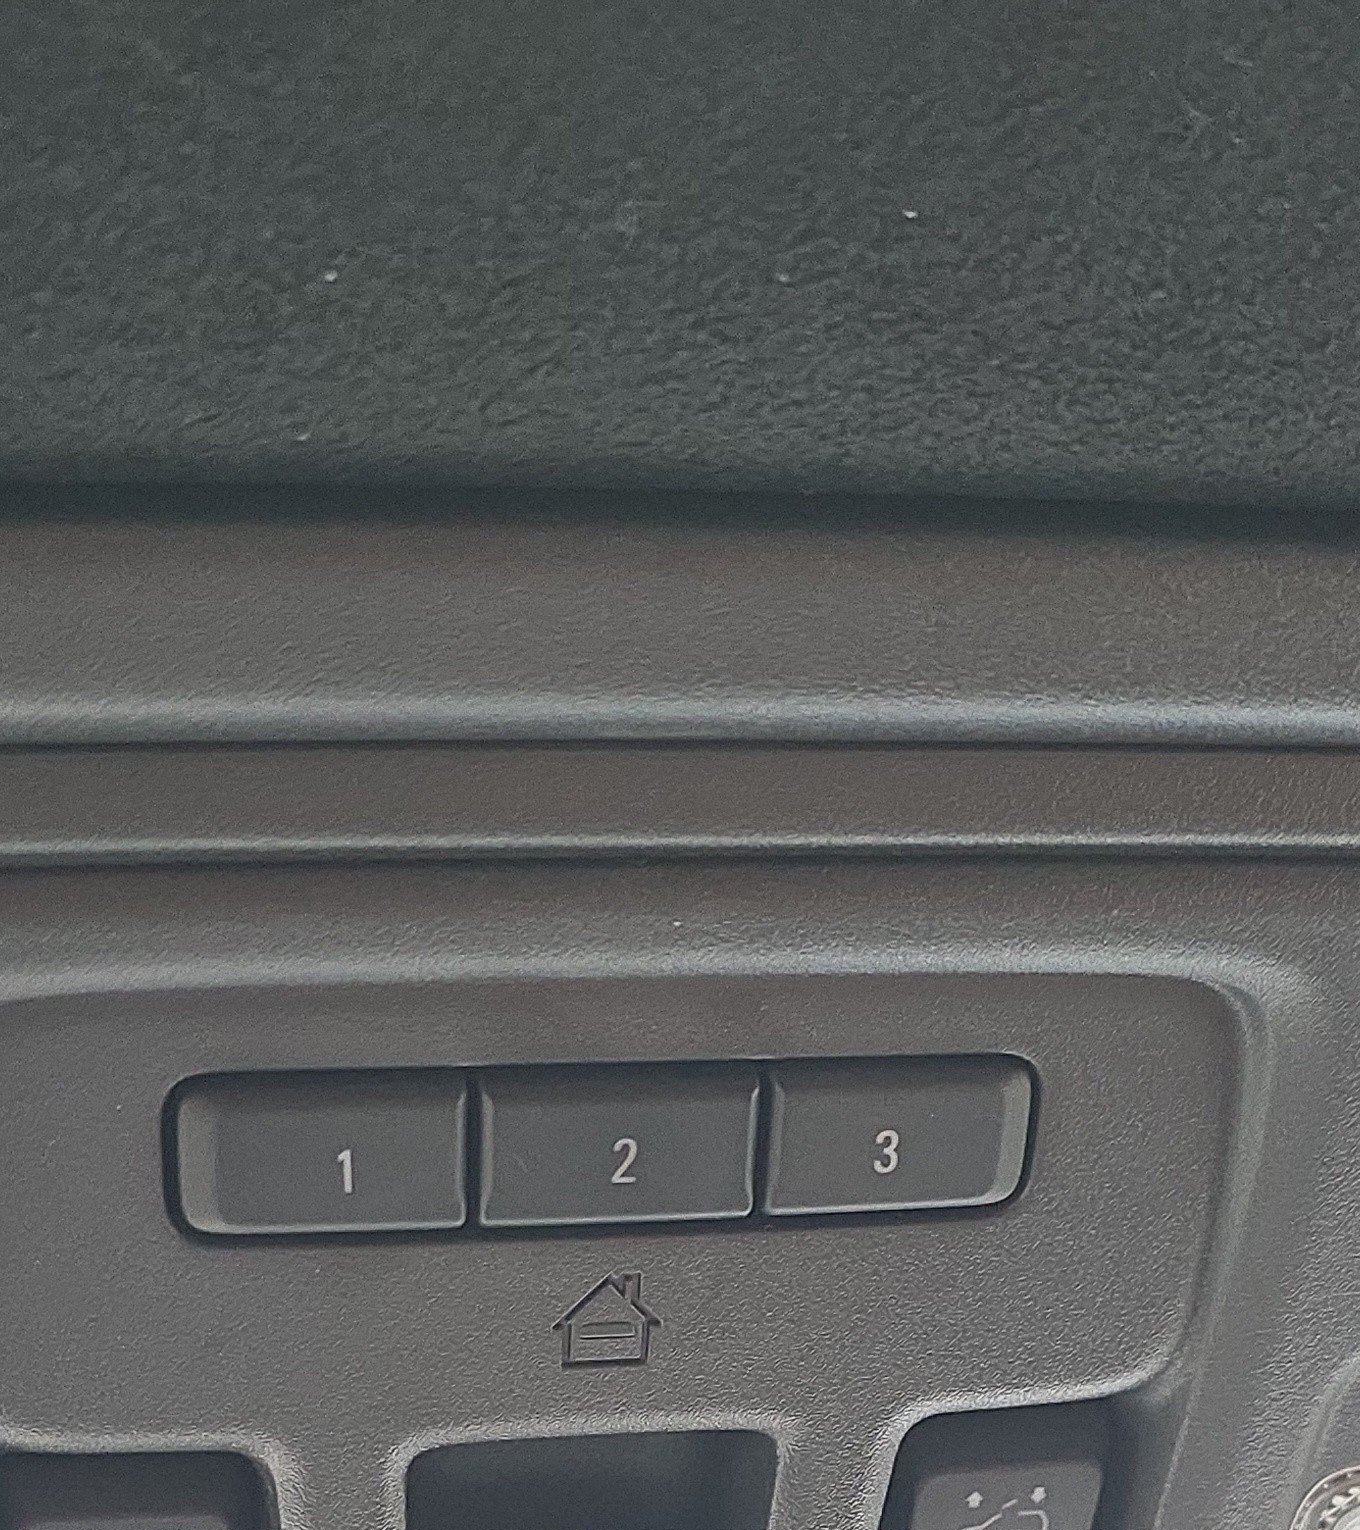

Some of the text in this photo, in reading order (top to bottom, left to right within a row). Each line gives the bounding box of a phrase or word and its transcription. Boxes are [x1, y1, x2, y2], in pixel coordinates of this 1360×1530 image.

[336, 1147, 355, 1194] 1
[611, 1138, 638, 1184] 2
[872, 1129, 900, 1175] 3
